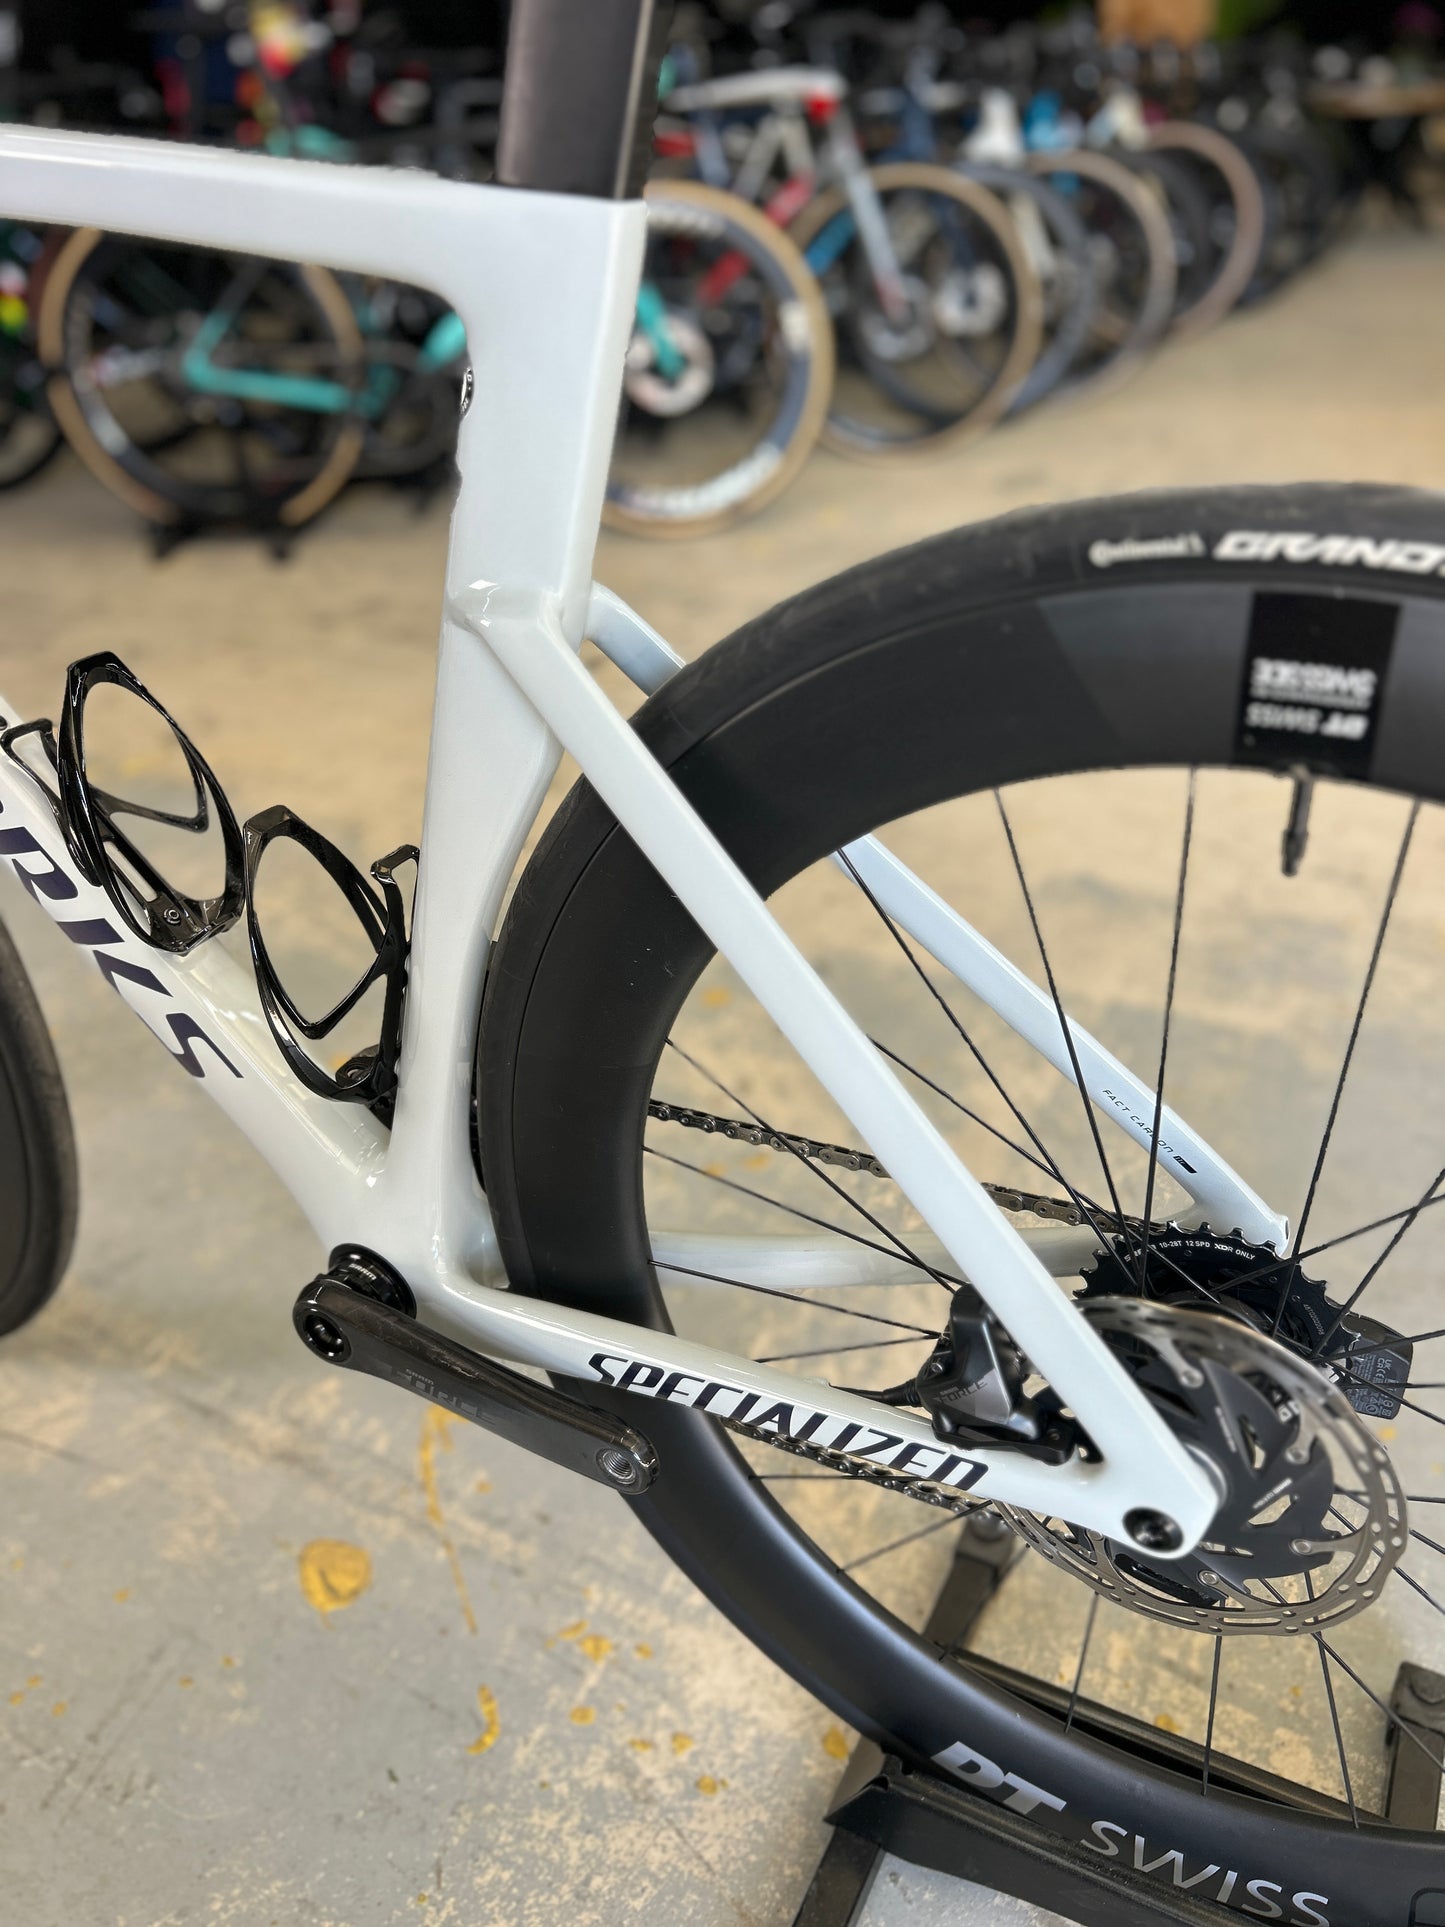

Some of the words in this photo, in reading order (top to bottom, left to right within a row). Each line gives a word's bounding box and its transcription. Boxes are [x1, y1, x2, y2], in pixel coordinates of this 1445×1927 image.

[0, 803, 244, 1078] RKS
[1102, 1089, 1131, 1112] FACT
[1130, 1115, 1174, 1153] CARON
[1160, 1240, 1182, 1249] 10-28T
[1195, 1240, 1210, 1248] SPD
[1235, 1249, 1255, 1260] ONLY
[587, 1352, 989, 1491] SPECIALIZED
[930, 1740, 1067, 1815] DT
[1080, 1820, 1330, 1927] SWISS
